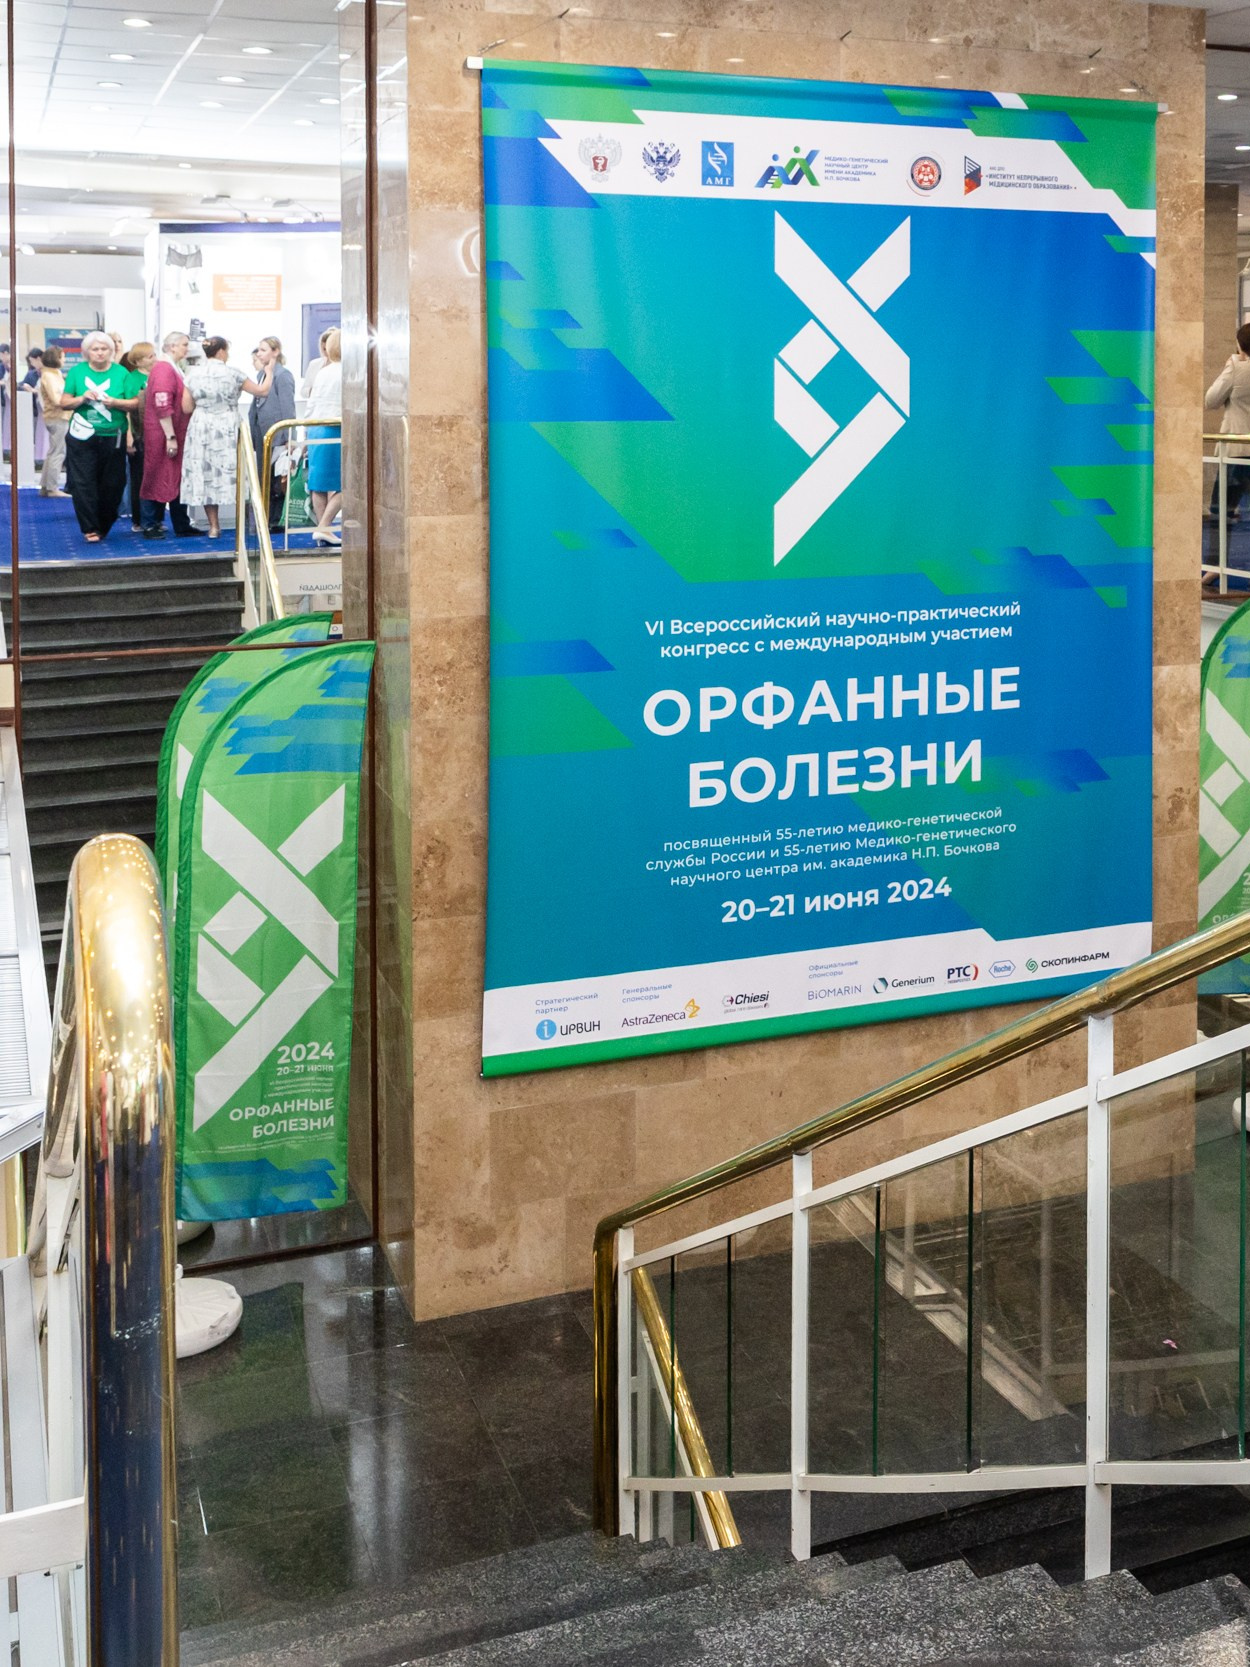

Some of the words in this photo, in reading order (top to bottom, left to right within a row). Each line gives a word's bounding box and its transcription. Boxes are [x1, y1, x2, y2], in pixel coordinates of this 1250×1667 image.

[989, 181, 1031, 189] МЕДИЦИНСКОГО
[1016, 174, 1058, 183] НЕПРЕРЫВНОГО
[670, 612, 821, 636] Всероссийский
[825, 601, 1021, 628] научно-практический
[660, 640, 750, 659] конгресс
[754, 640, 765, 652] с
[769, 631, 926, 653] международным
[930, 626, 1013, 645] участием
[642, 666, 1021, 737] ОРФАННЫЕ
[688, 739, 983, 808] БОЛЕЗНИ
[663, 829, 772, 852] посвященный
[776, 823, 844, 841] 55-летию
[847, 807, 1003, 833] медико-генетической
[645, 854, 706, 872] службы
[711, 849, 766, 865] России
[770, 848, 780, 858] и
[783, 839, 851, 857] 55-летию
[855, 823, 1017, 850] Медико-генетического
[670, 868, 742, 887] научного
[745, 863, 799, 879] центра
[803, 860, 827, 872] им.
[830, 851, 908, 869] академика
[911, 846, 940, 860] Н.П.
[943, 841, 1001, 857] Бочкова
[804, 888, 879, 914] июня
[887, 876, 953, 904] 2024
[808, 960, 859, 972] Официальные
[1041, 951, 1110, 968] СКОПИНФАРМ
[808, 970, 844, 979] спонсоры
[947, 964, 971, 980] PTC
[993, 964, 1012, 974] Roche
[622, 983, 673, 995] Генеральные
[891, 974, 935, 988] Generium
[535, 992, 599, 1006] Стратегический
[622, 993, 660, 1004] спонсоры
[735, 990, 770, 1005] Chiesi
[535, 1005, 569, 1015] партнер
[621, 1010, 686, 1028] AstraZeneca
[277, 1042, 335, 1064] 2024
[307, 1064, 334, 1073] июня
[229, 1097, 335, 1121] ОРФАННЫЕ
[252, 1115, 335, 1139] БОЛЕЗНИ
